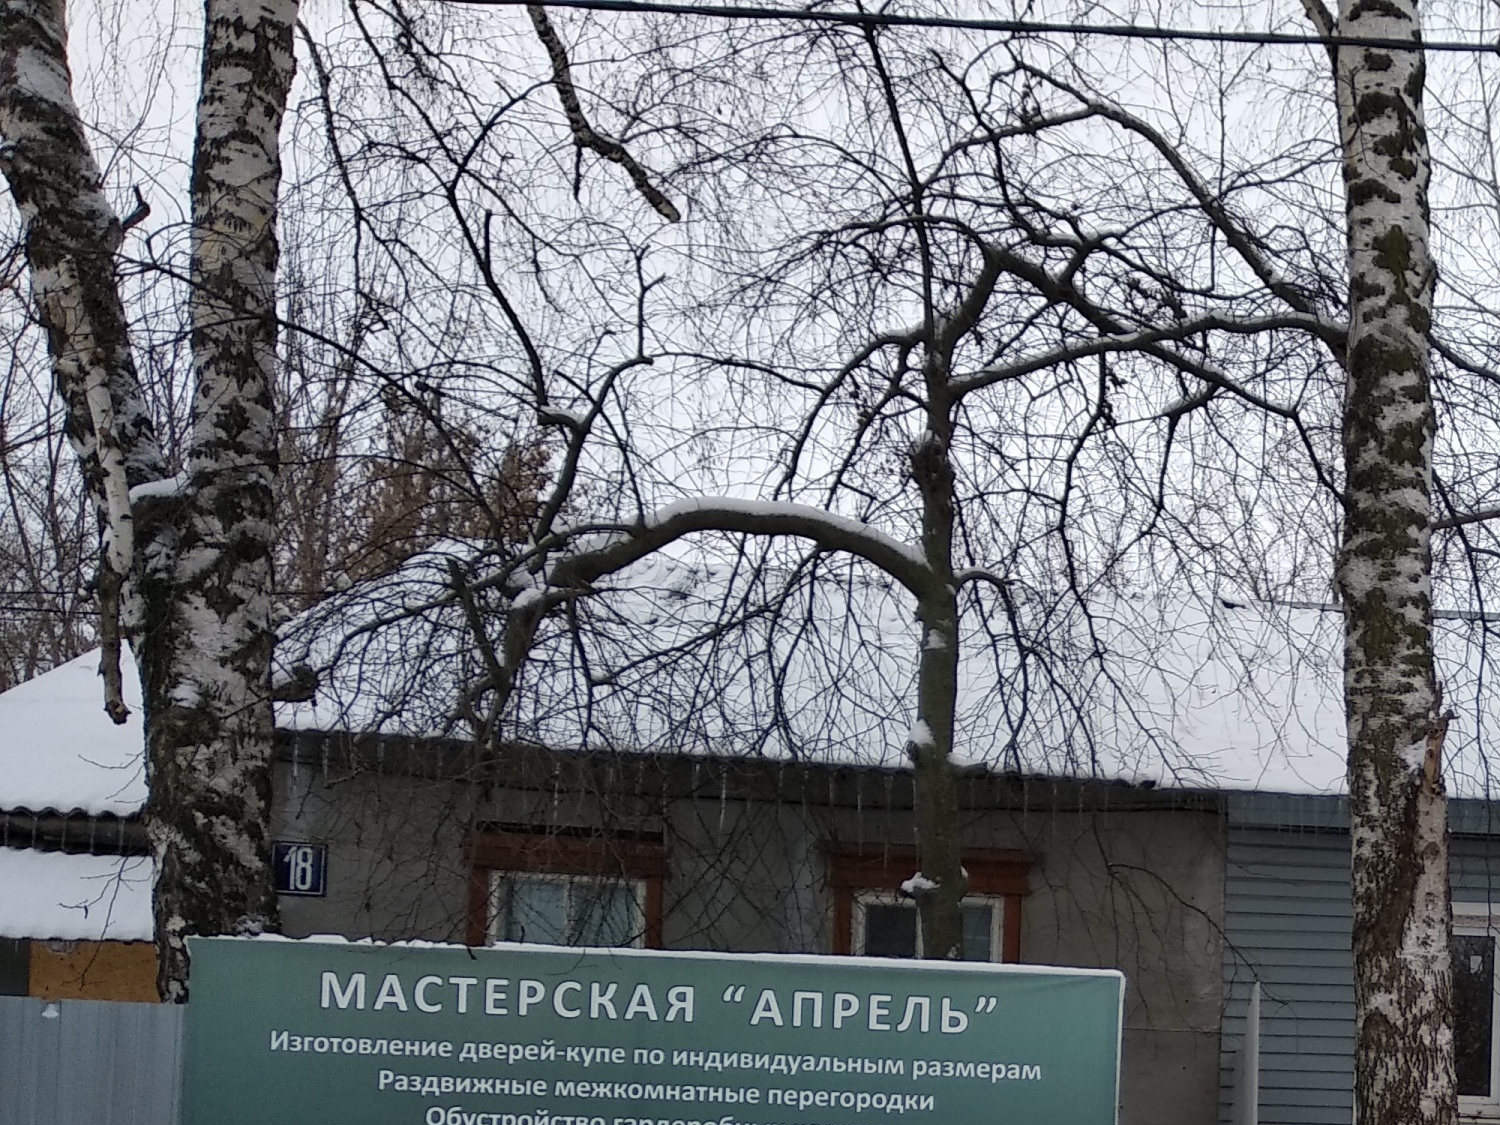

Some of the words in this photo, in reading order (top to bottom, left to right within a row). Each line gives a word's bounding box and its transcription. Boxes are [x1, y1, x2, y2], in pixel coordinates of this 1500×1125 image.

[283, 845, 313, 890] 18
[320, 971, 694, 1022] МАСТЕРСКАЯ
[270, 1030, 453, 1060] Изготовление
[458, 1038, 626, 1068] дверей-купе
[633, 1050, 665, 1066] по
[672, 1050, 905, 1076] индивидуальным
[912, 1060, 1042, 1084] размерам
[378, 1069, 547, 1097] Раздвижные
[554, 1081, 760, 1104] межкомнатные
[768, 1089, 934, 1114] перегородки
